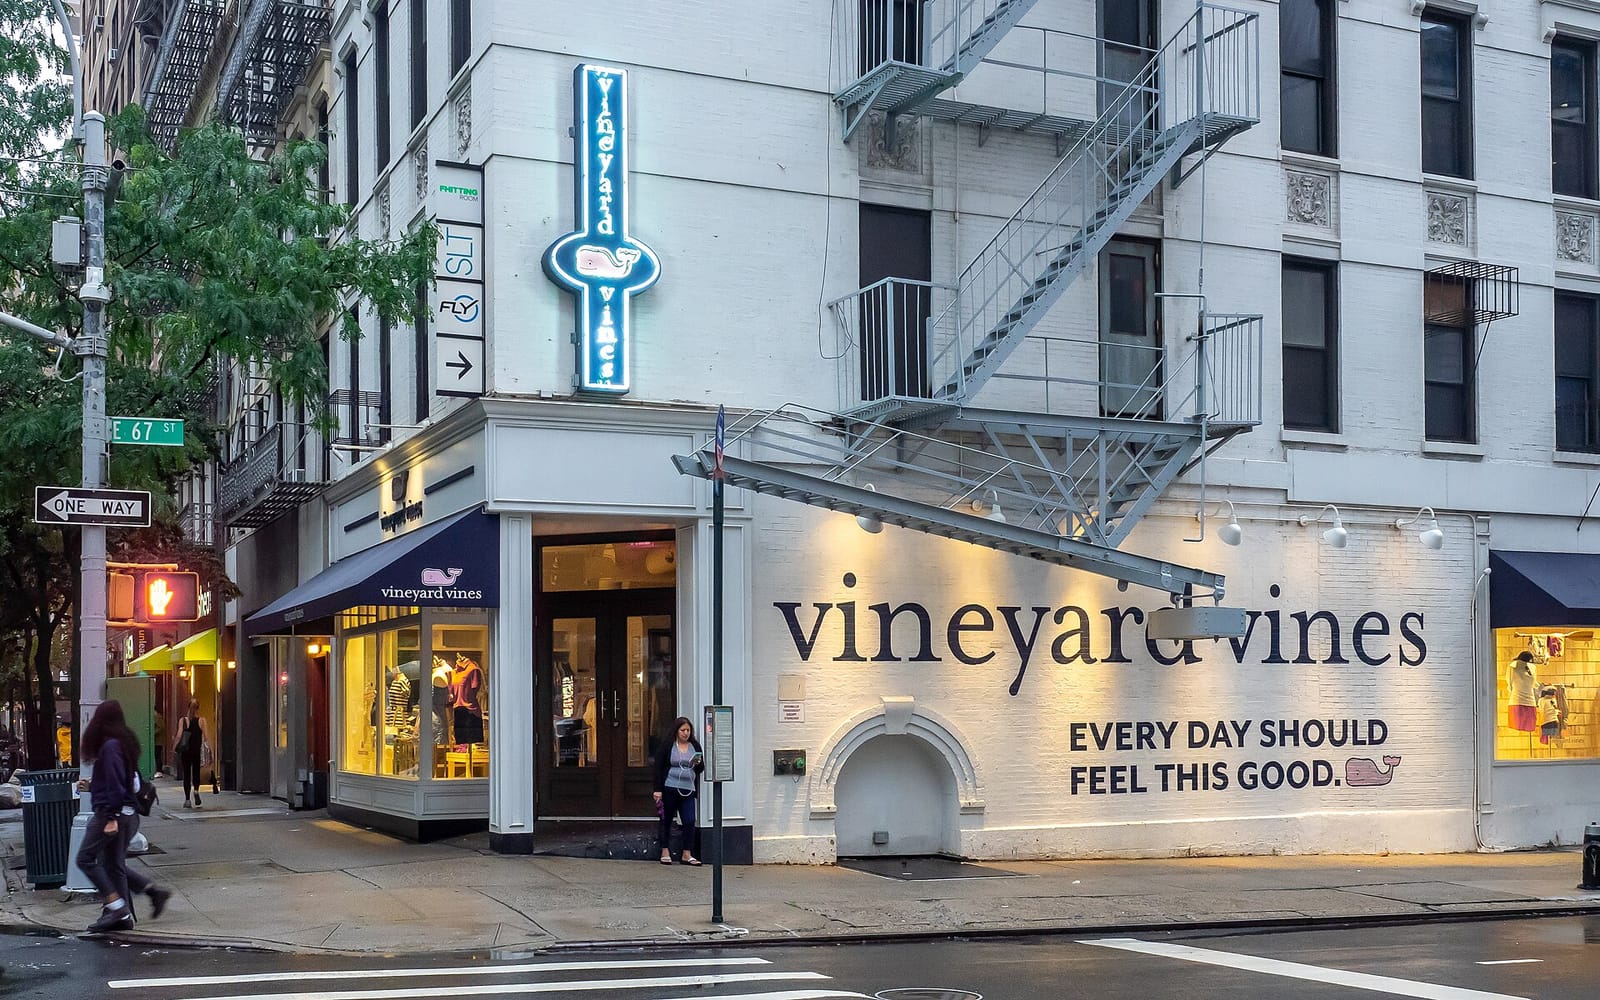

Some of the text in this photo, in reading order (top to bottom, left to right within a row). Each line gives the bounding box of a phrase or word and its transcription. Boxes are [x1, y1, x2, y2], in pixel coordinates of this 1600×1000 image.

[595, 76, 615, 236] vineyard
[440, 185, 478, 196] FHITTING
[446, 227, 473, 275] SLT
[440, 300, 478, 315] FLY
[598, 287, 618, 378] vines
[113, 421, 176, 440] E 67 ST
[54, 499, 135, 514] ONE WAY
[381, 586, 482, 602] vineyard vines
[1228, 583, 1428, 667] vines
[1070, 719, 1388, 752] EVERY DAY SHOULD
[1070, 760, 1341, 795] FEEL THIS GOOD.
